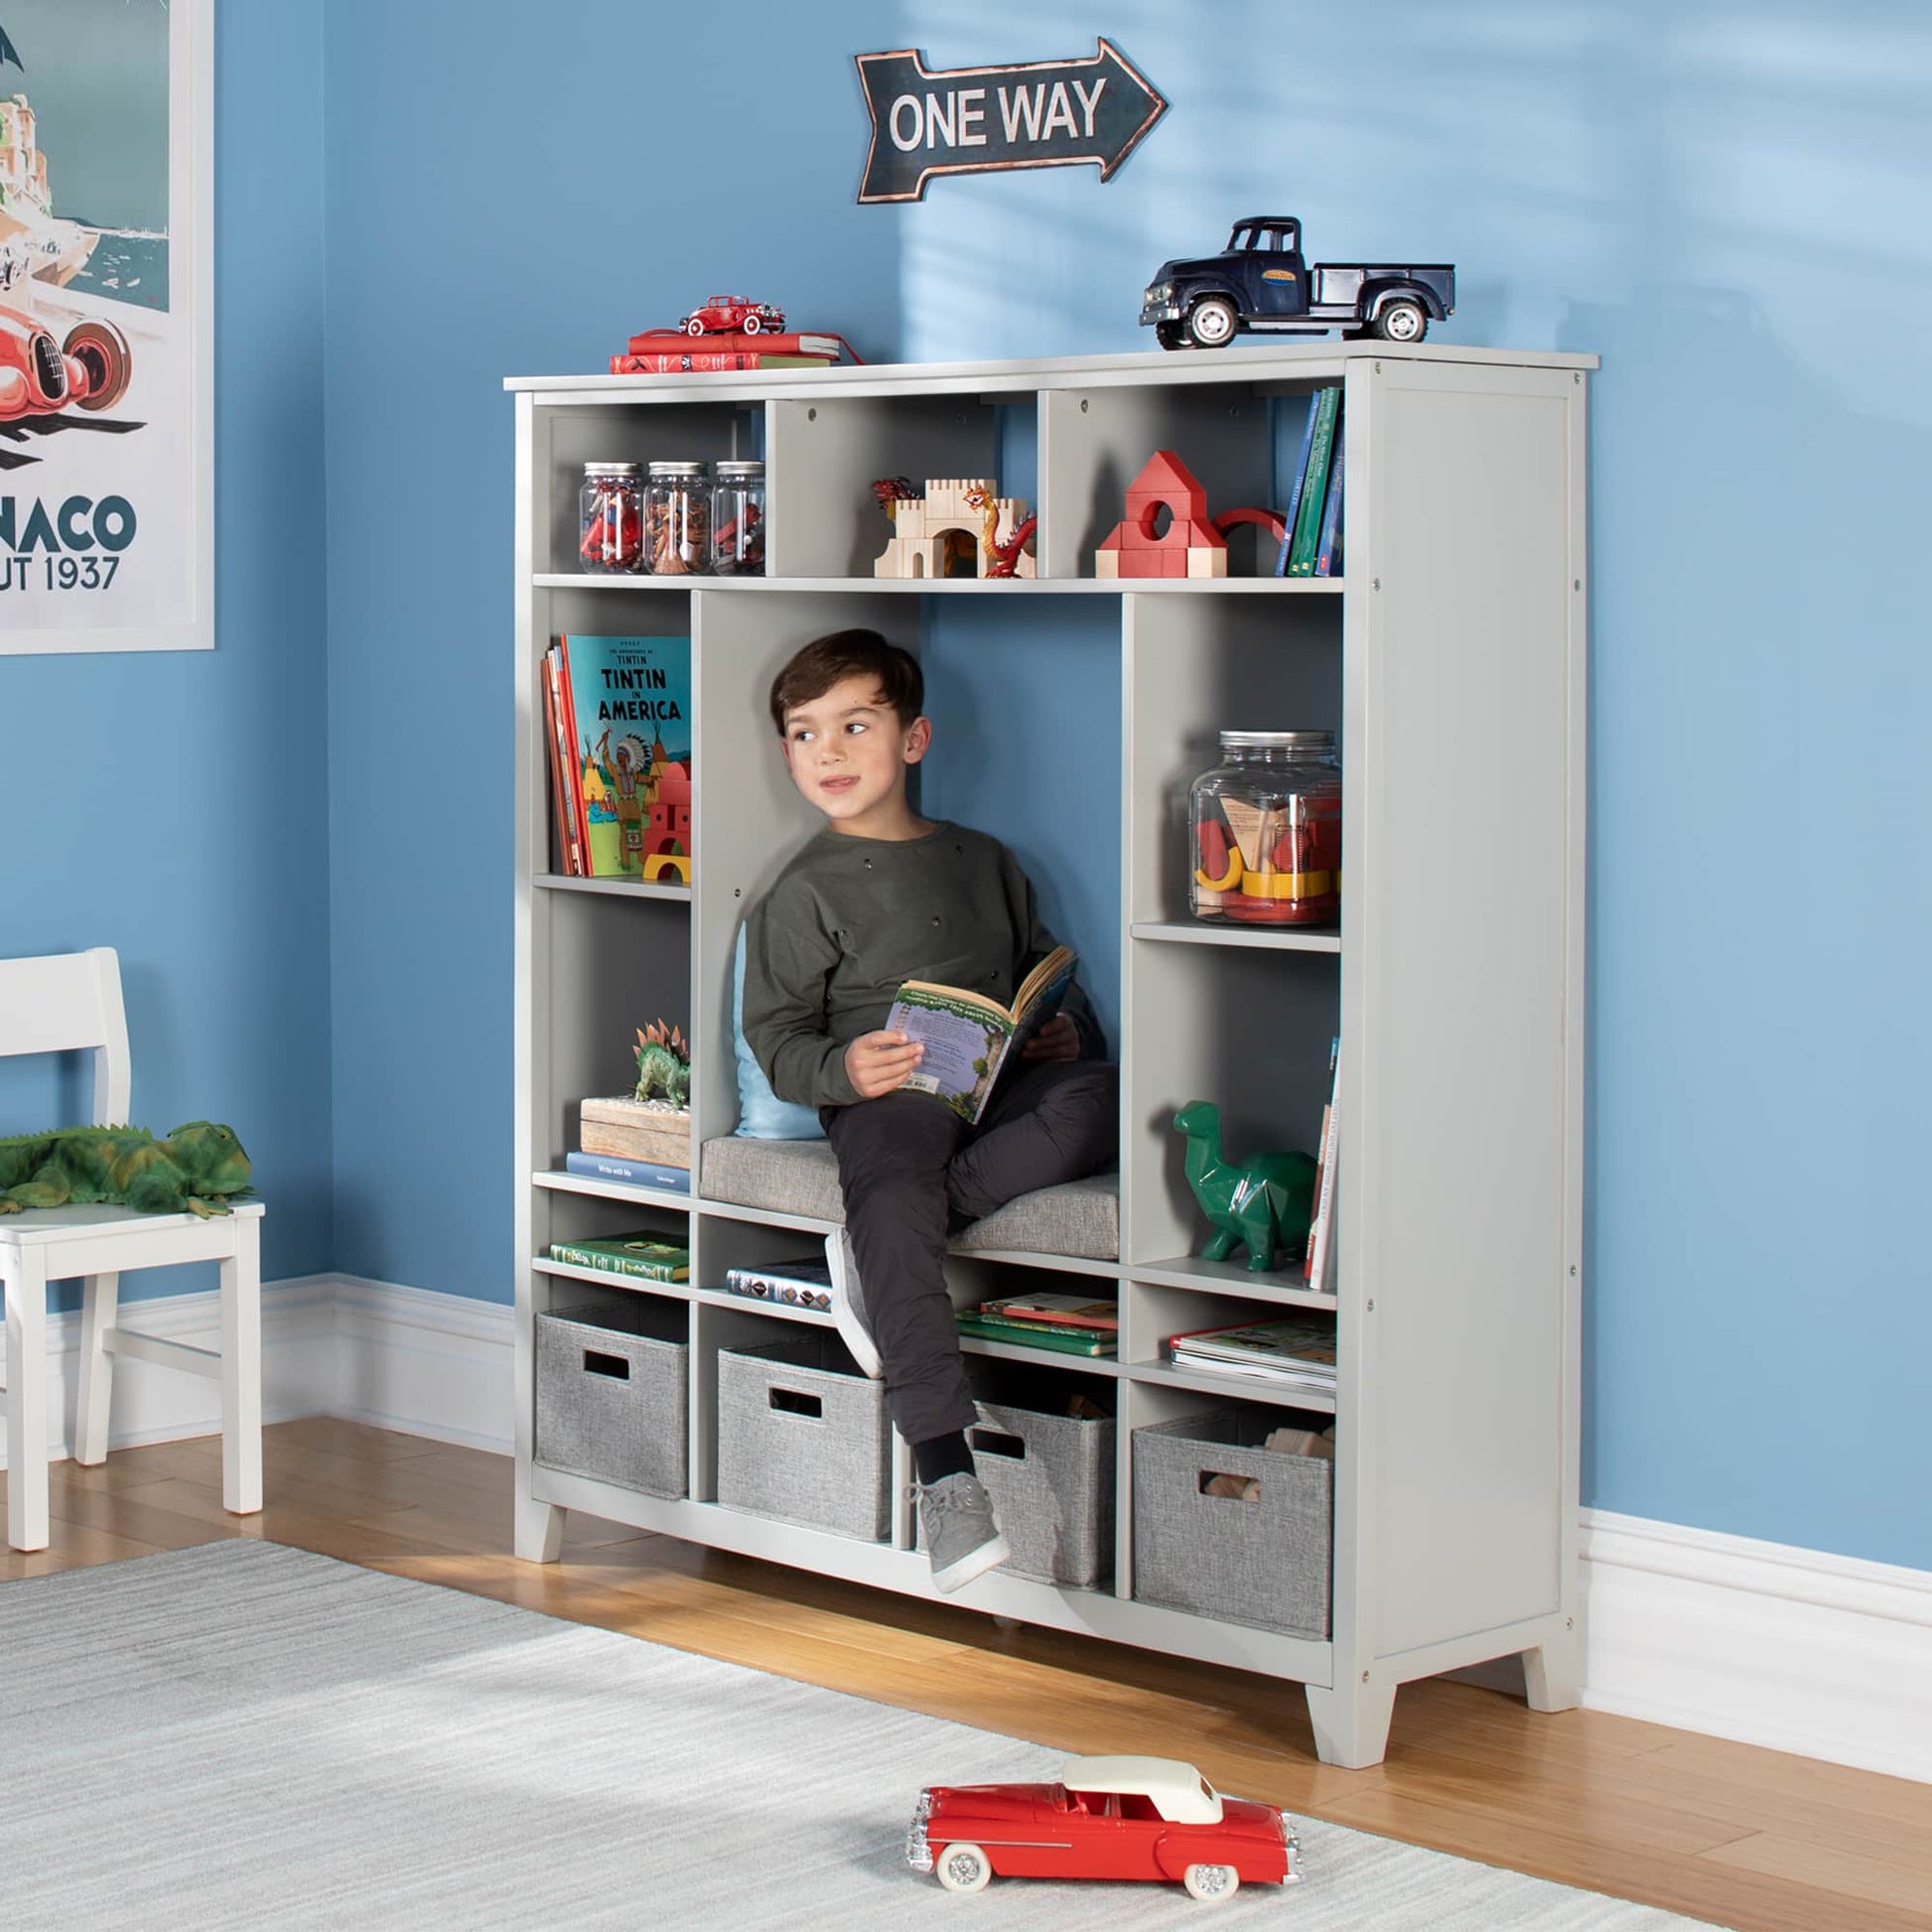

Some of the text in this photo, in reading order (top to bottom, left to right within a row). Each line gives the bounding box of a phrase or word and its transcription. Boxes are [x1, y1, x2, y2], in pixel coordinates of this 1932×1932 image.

[890, 77, 1107, 152] ONE WAY
[45, 556, 120, 591] 1937
[617, 655, 647, 665] TINTIN
[601, 668, 666, 689] TINTIN
[599, 700, 682, 721] AMERICA
